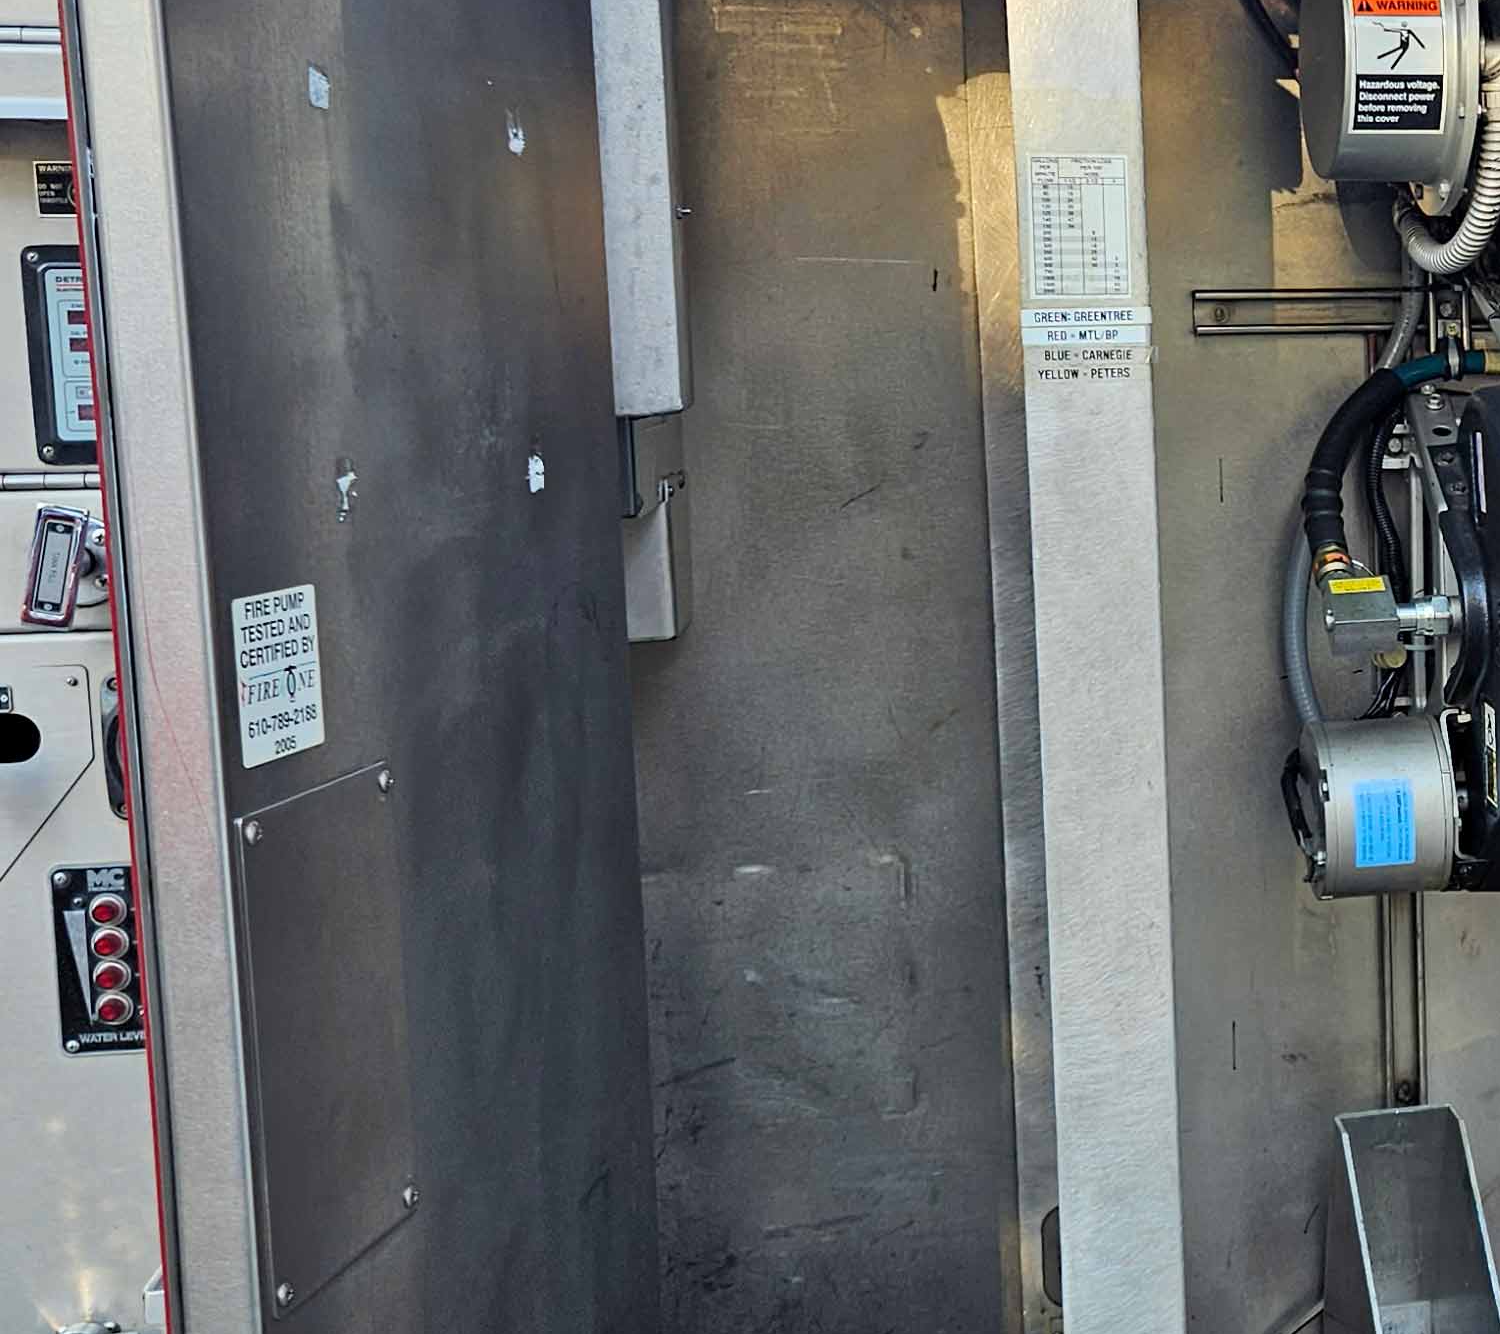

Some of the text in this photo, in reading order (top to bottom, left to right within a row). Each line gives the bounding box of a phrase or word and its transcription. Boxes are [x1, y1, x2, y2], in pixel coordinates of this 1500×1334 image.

[1376, 0, 1438, 11] WARNING
[1359, 80, 1405, 89] Hazardous
[1359, 92, 1436, 104] Disconnect power
[1358, 103, 1427, 114] before removing
[1357, 114, 1400, 123] this cover
[1074, 310, 1133, 322] GREENTREE
[1047, 330, 1067, 341] RED
[1044, 350, 1071, 361] BLUE
[1082, 349, 1132, 360] CARNEGIE
[1038, 369, 1079, 380] YELLOW
[1090, 367, 1131, 379] PETERS
[244, 592, 304, 620] FIRE PUMP
[240, 614, 311, 644] TESTED AND
[240, 636, 316, 668] CERTIFIED BY
[247, 678, 280, 705] FIRE
[79, 1031, 118, 1044] WATER
